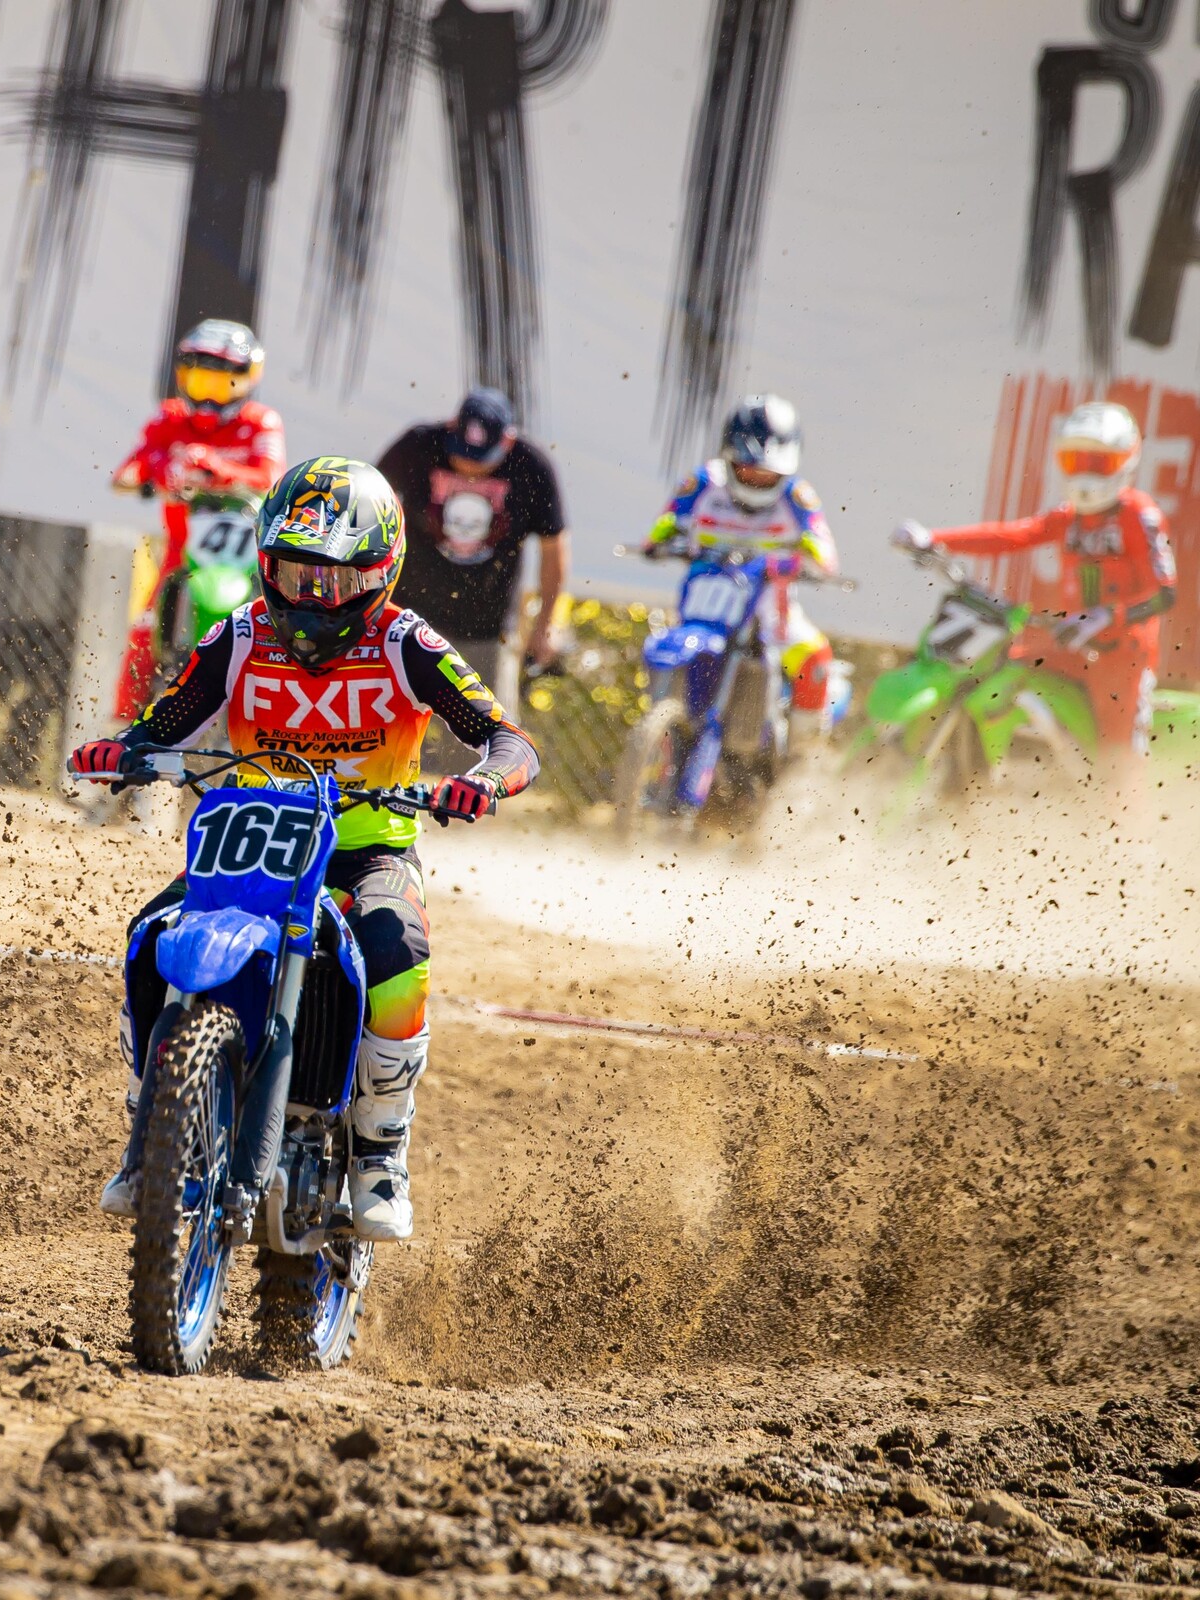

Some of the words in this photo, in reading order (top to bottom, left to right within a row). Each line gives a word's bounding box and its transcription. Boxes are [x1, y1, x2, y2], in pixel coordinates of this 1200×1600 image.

[243, 673, 396, 730] FXR
[271, 729, 310, 741] ROCKY
[312, 728, 378, 742] MOUNTAIN
[191, 803, 326, 880] 165
